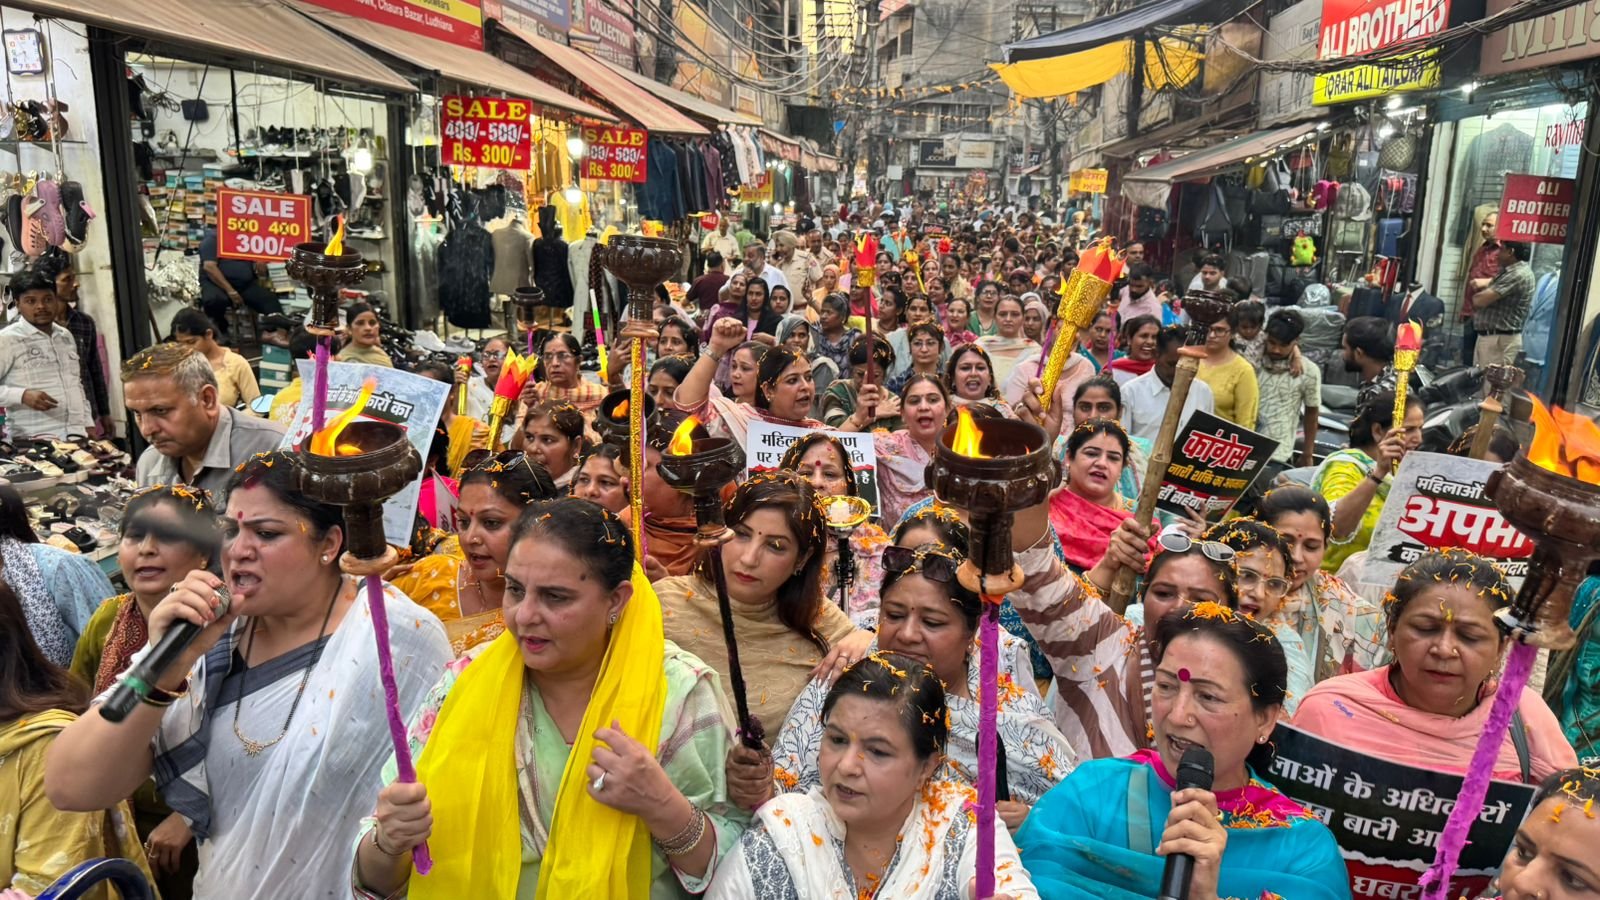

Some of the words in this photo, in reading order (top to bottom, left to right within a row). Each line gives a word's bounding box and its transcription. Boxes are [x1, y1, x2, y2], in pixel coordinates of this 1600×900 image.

[1319, 20, 1345, 61] ALI
[1346, 0, 1447, 57] BROTHERS
[446, 99, 527, 120] SALE
[584, 129, 644, 146] SALE
[453, 144, 476, 162] Rs.
[481, 145, 522, 166] 300/-
[589, 162, 606, 176] Rs.
[610, 164, 640, 180] 300/-
[1536, 181, 1559, 196] ALI
[231, 196, 295, 218] SALE
[1507, 199, 1571, 217] BROTHER
[227, 217, 259, 232] 500
[268, 221, 300, 236] 400
[702, 214, 717, 225] SALE
[1512, 219, 1568, 237] TAILORS
[236, 234, 293, 256] 300/-
[757, 451, 773, 463] पर
[1182, 429, 1254, 470] कांग्रेस
[1167, 463, 1194, 479] नारी
[1343, 771, 1376, 801] के
[1343, 811, 1400, 842] बारी
